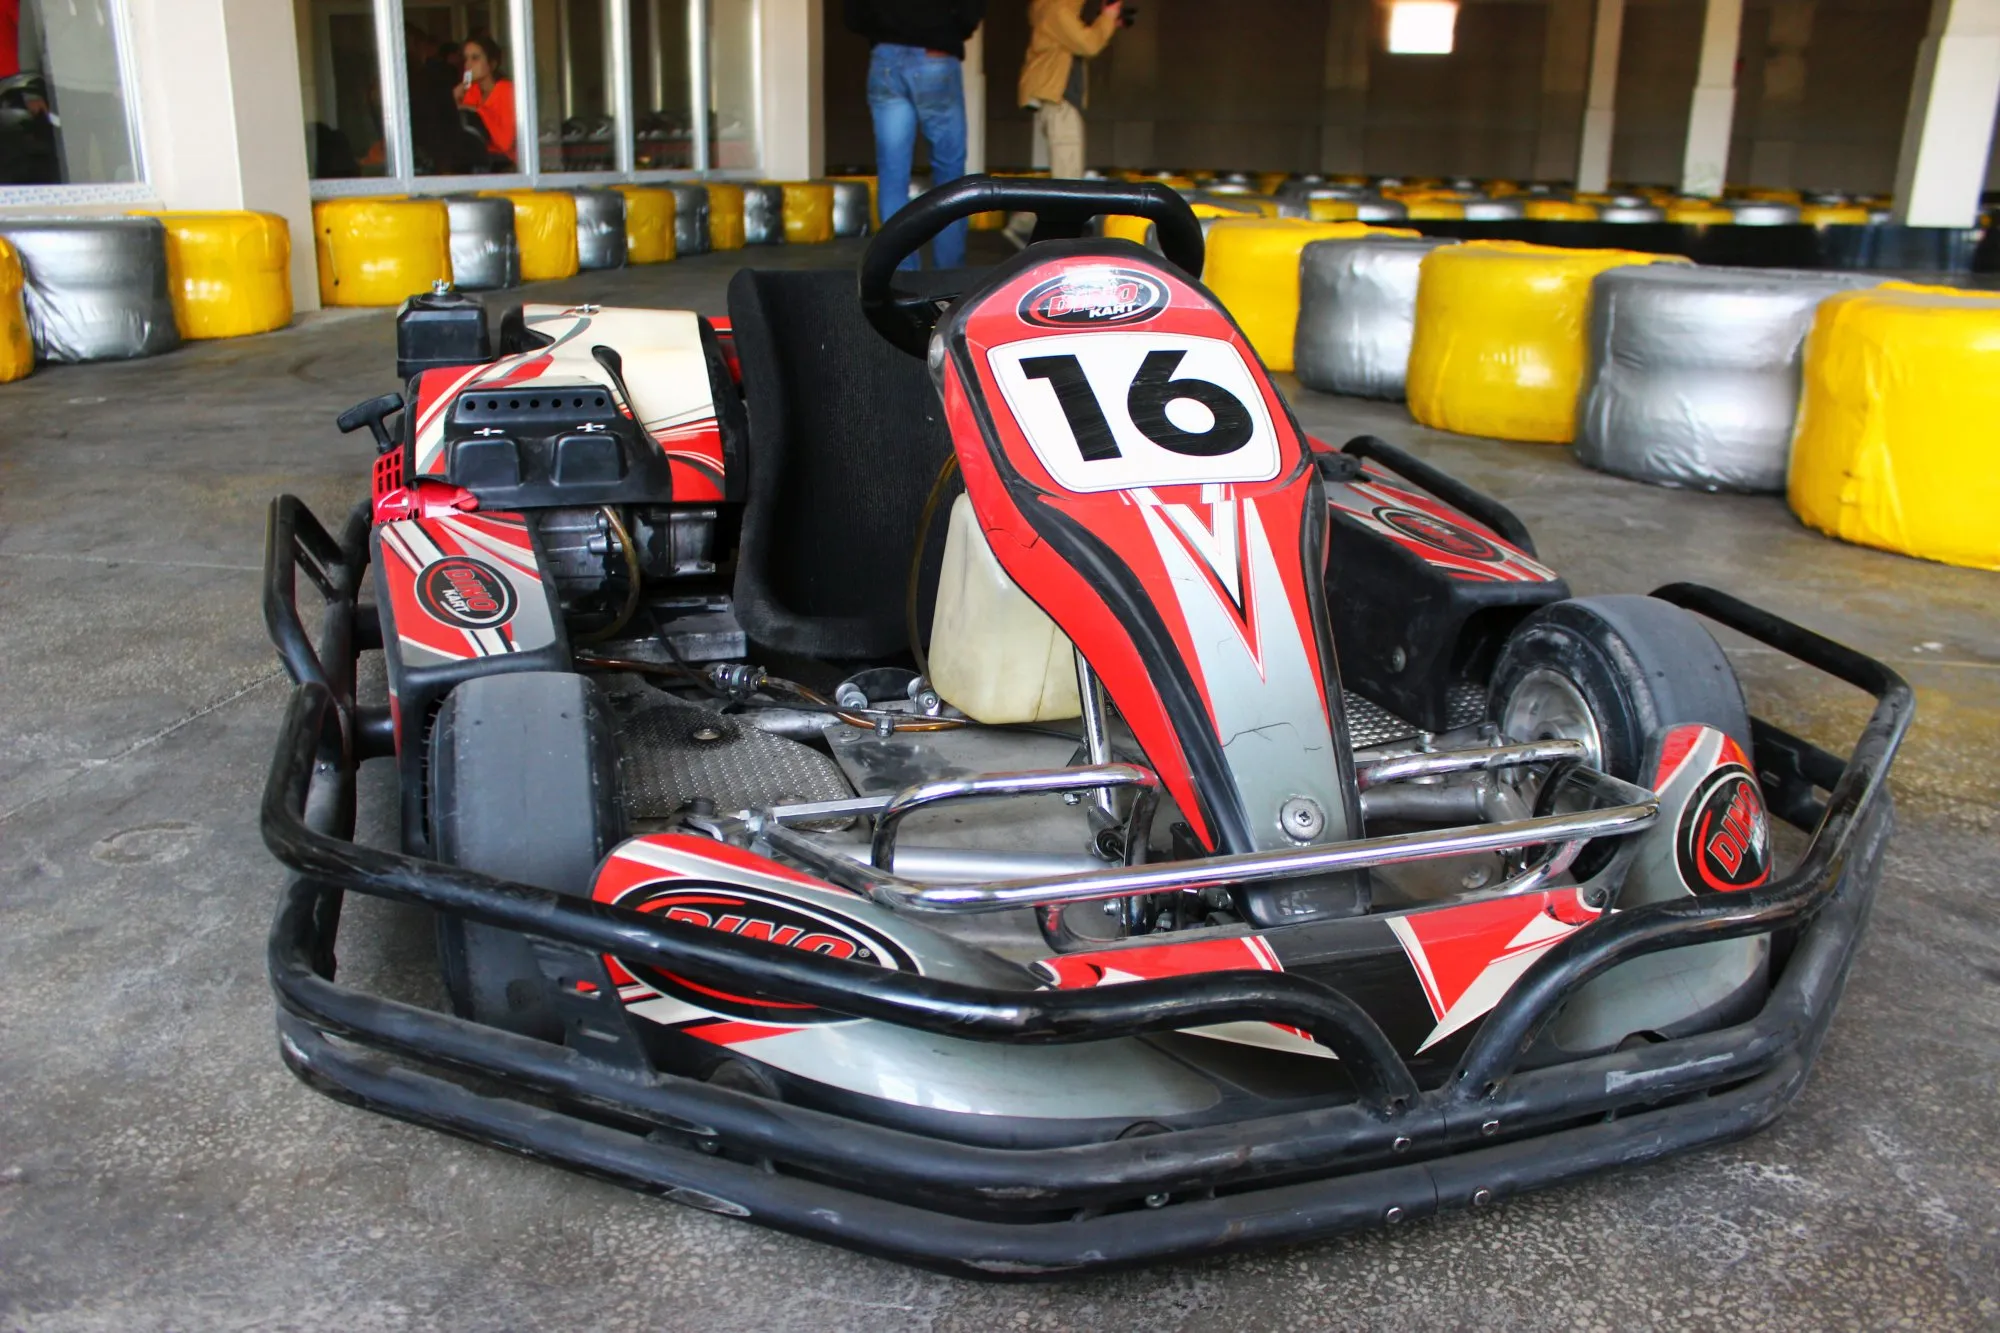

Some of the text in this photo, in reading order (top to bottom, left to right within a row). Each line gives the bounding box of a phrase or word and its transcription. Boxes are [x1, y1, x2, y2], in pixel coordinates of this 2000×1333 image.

[1088, 303, 1137, 318] KART
[1018, 350, 1253, 462] 16
[442, 568, 498, 611] DINO
[442, 589, 470, 613] KART
[1707, 780, 1760, 879] DINO
